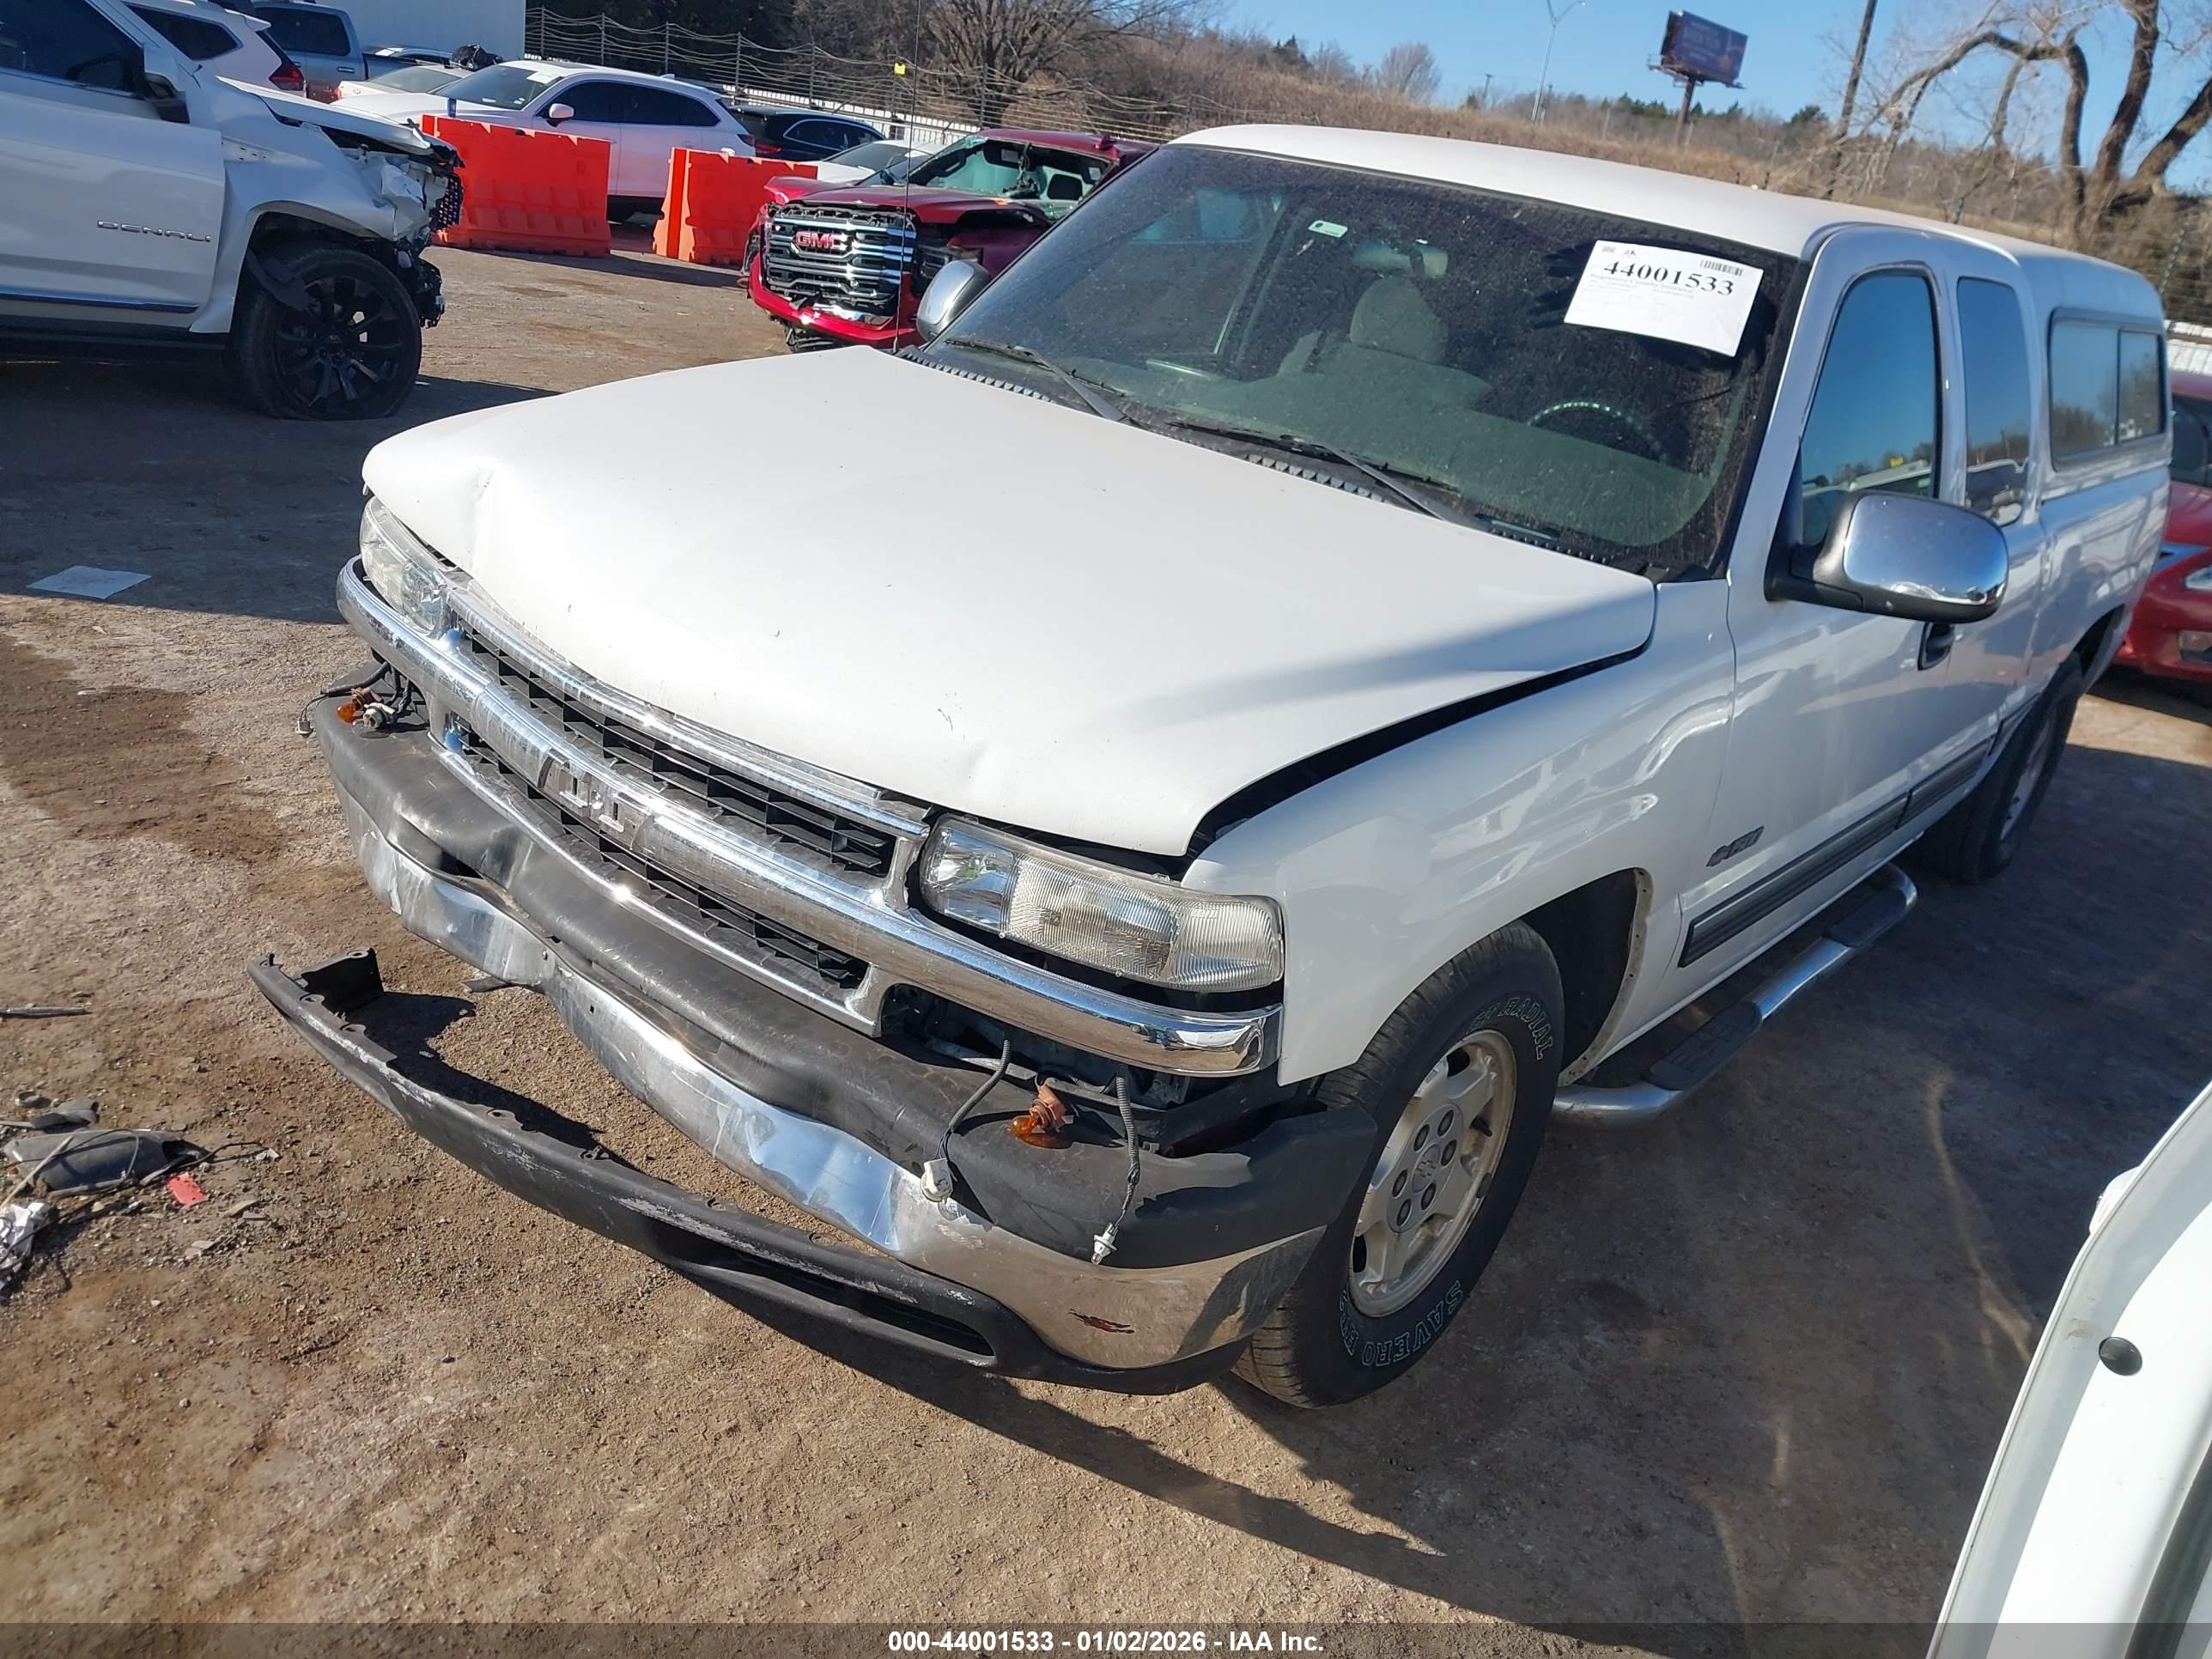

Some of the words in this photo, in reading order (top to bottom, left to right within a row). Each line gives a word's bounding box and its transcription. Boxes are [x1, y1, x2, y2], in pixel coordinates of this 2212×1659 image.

[97, 221, 211, 242] DENALI
[795, 231, 848, 251] GMC
[1603, 260, 1734, 296] 44001533
[1498, 996, 1553, 1060] RADIAL
[1361, 1279, 1464, 1367] SAVERO
